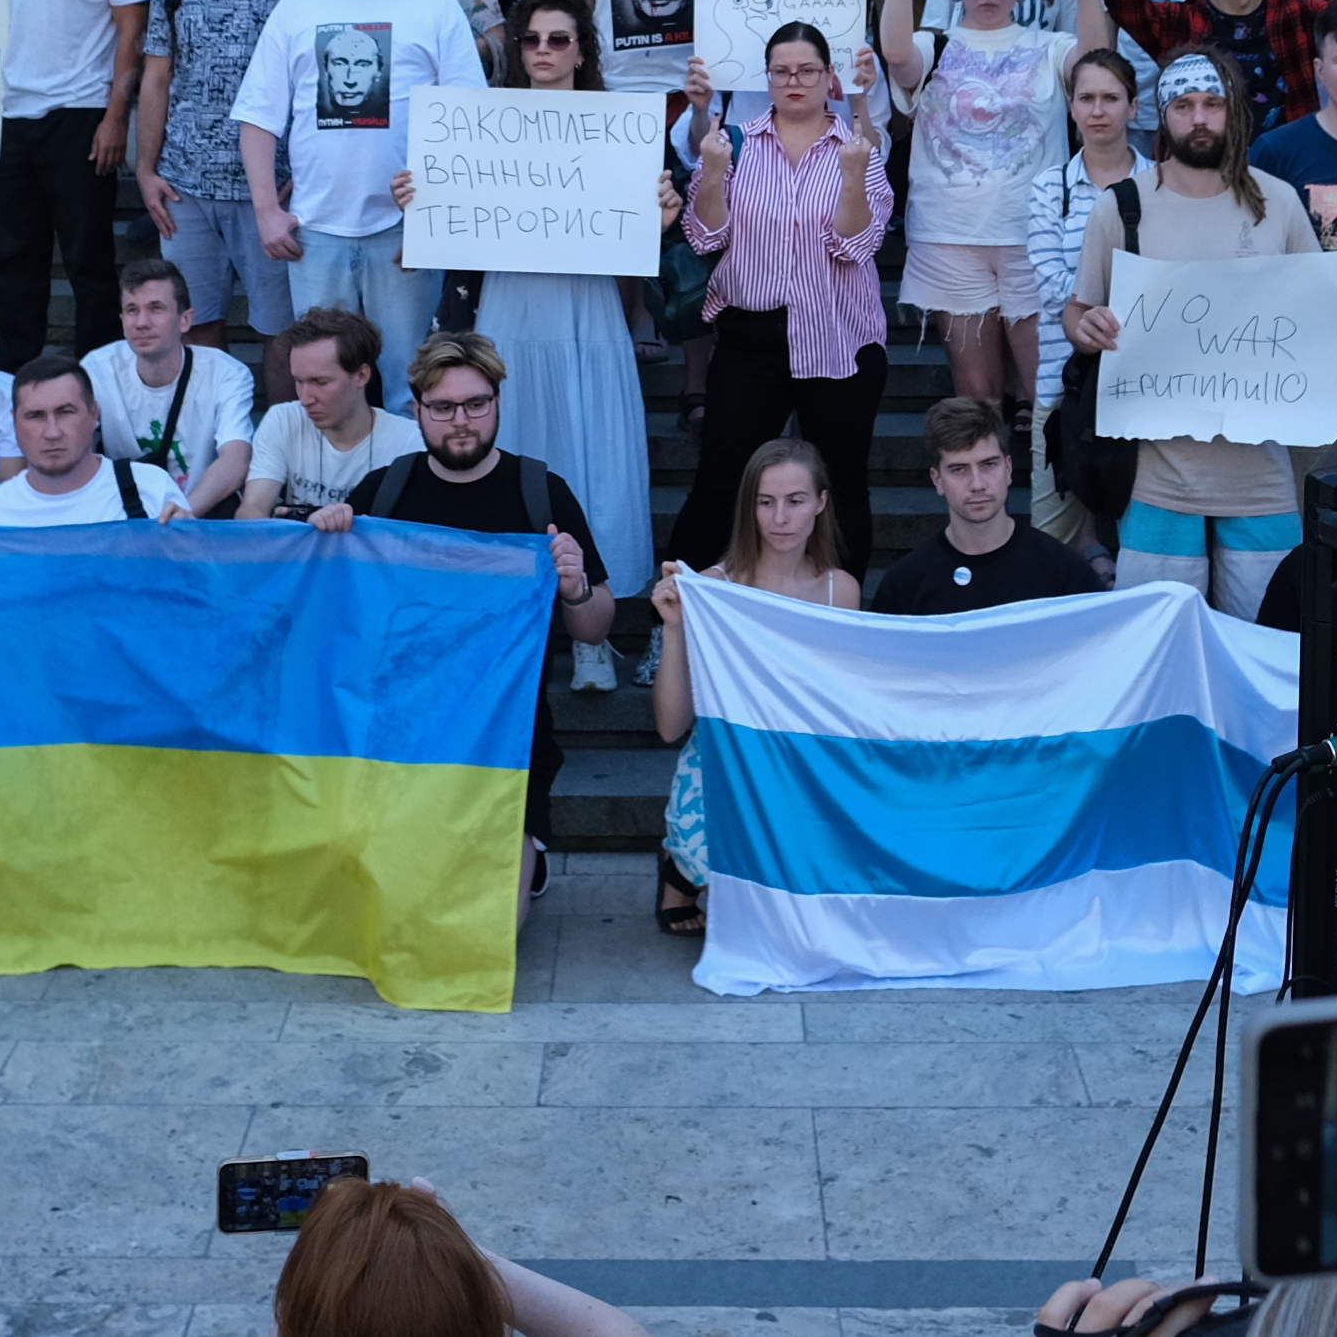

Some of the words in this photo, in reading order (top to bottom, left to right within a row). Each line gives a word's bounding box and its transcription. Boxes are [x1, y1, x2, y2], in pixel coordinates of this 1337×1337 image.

[615, 34, 650, 47] PUTIN
[651, 34, 663, 44] IS
[665, 33, 674, 43] A
[424, 102, 662, 145] ЗАКОМПЛЕКСО-
[424, 155, 584, 191] ВАННЫЙ
[416, 205, 640, 240] ТЕРРОРИСТ
[1124, 288, 1211, 333] NO
[1197, 315, 1297, 361] WAR
